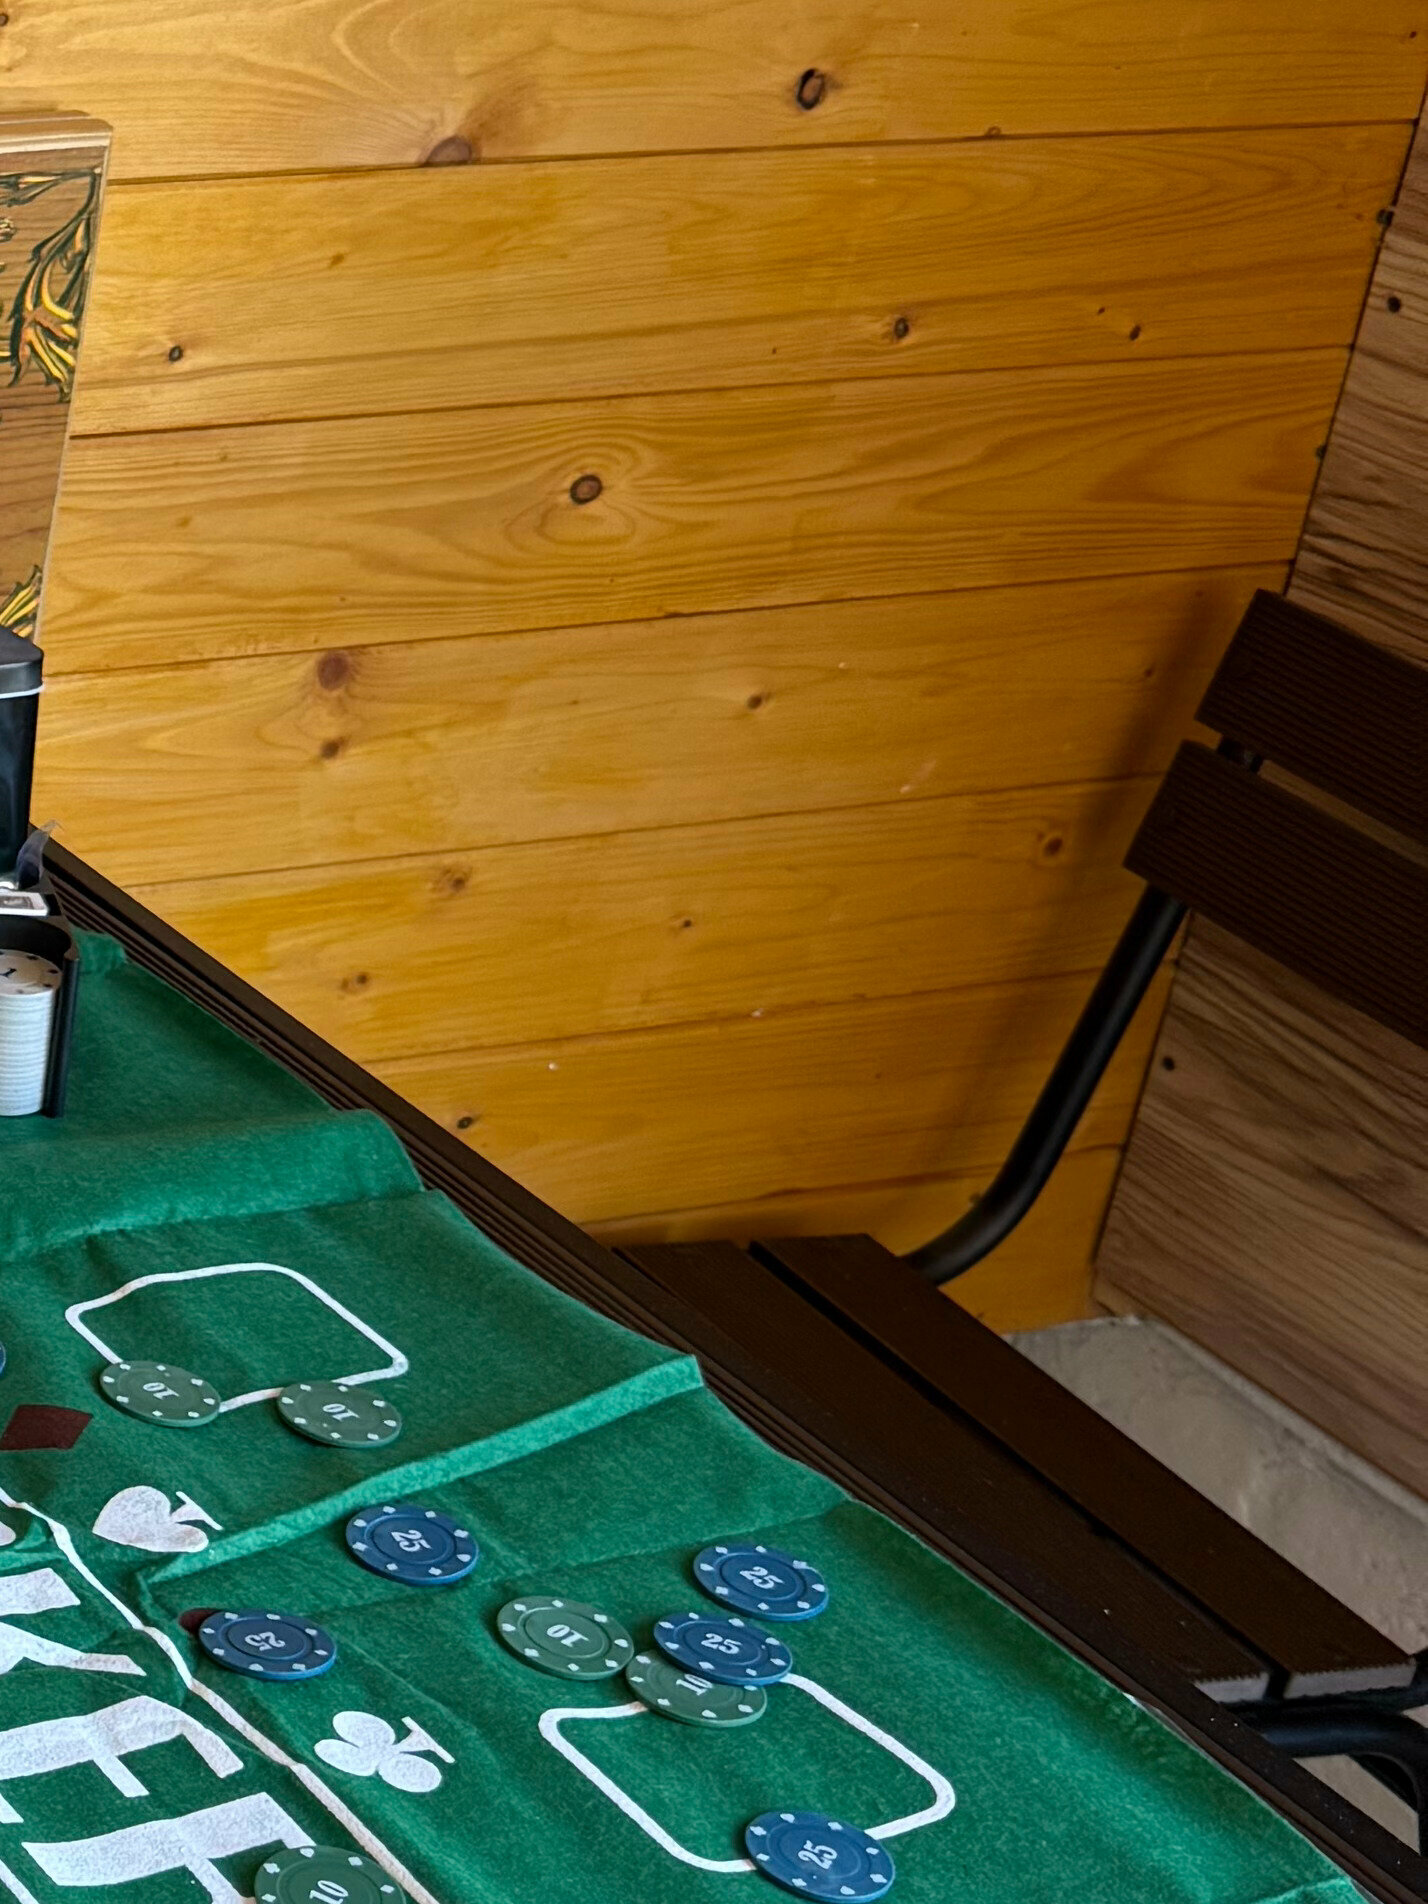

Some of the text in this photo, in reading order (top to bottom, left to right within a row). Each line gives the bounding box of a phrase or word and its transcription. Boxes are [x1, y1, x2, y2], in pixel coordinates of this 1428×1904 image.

[142, 1381, 179, 1400] 10
[322, 1402, 357, 1423] 10
[390, 1528, 432, 1553] 25
[738, 1566, 783, 1590] 25
[243, 1630, 287, 1652] 25
[545, 1623, 591, 1648] 10
[700, 1633, 741, 1656] 25
[675, 1672, 714, 1696] 10
[798, 1842, 839, 1870] 25
